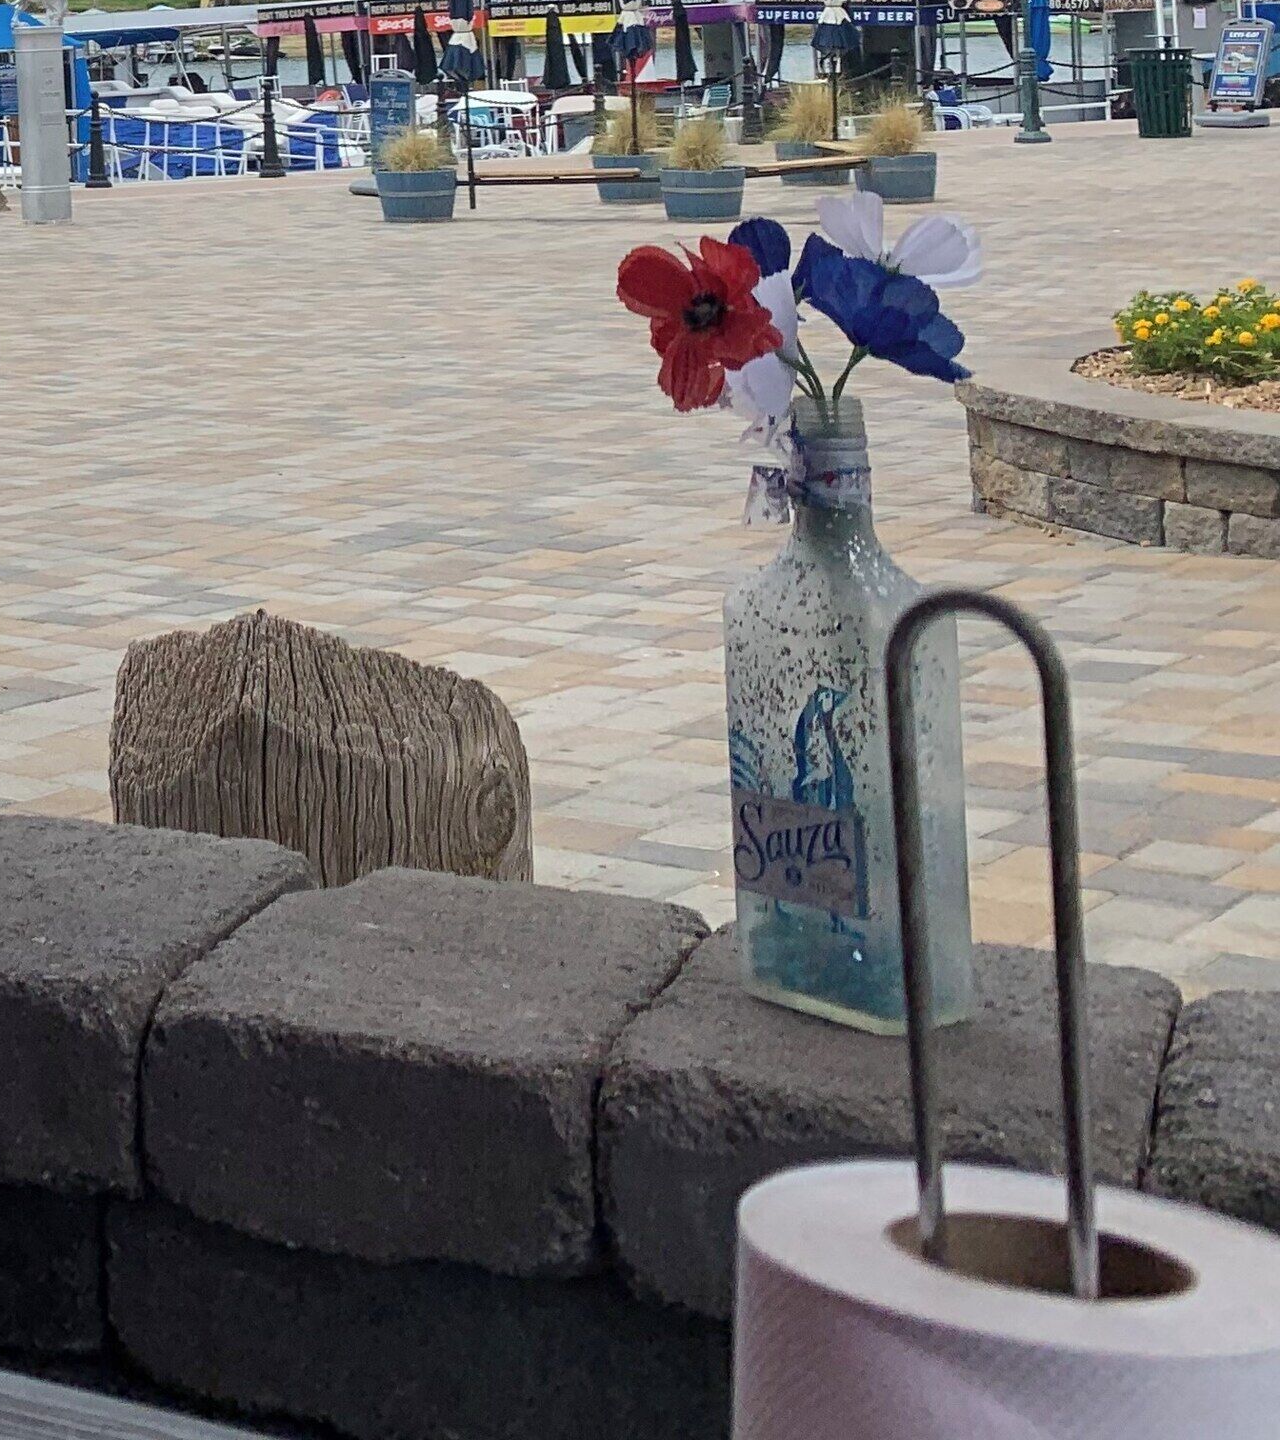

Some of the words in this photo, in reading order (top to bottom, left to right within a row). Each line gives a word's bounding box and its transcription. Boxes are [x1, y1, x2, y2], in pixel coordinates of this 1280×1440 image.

[490, 6, 510, 17] RENT
[512, 5, 529, 16] THIS
[878, 11, 914, 22] BEER
[733, 801, 852, 882] Sauza
